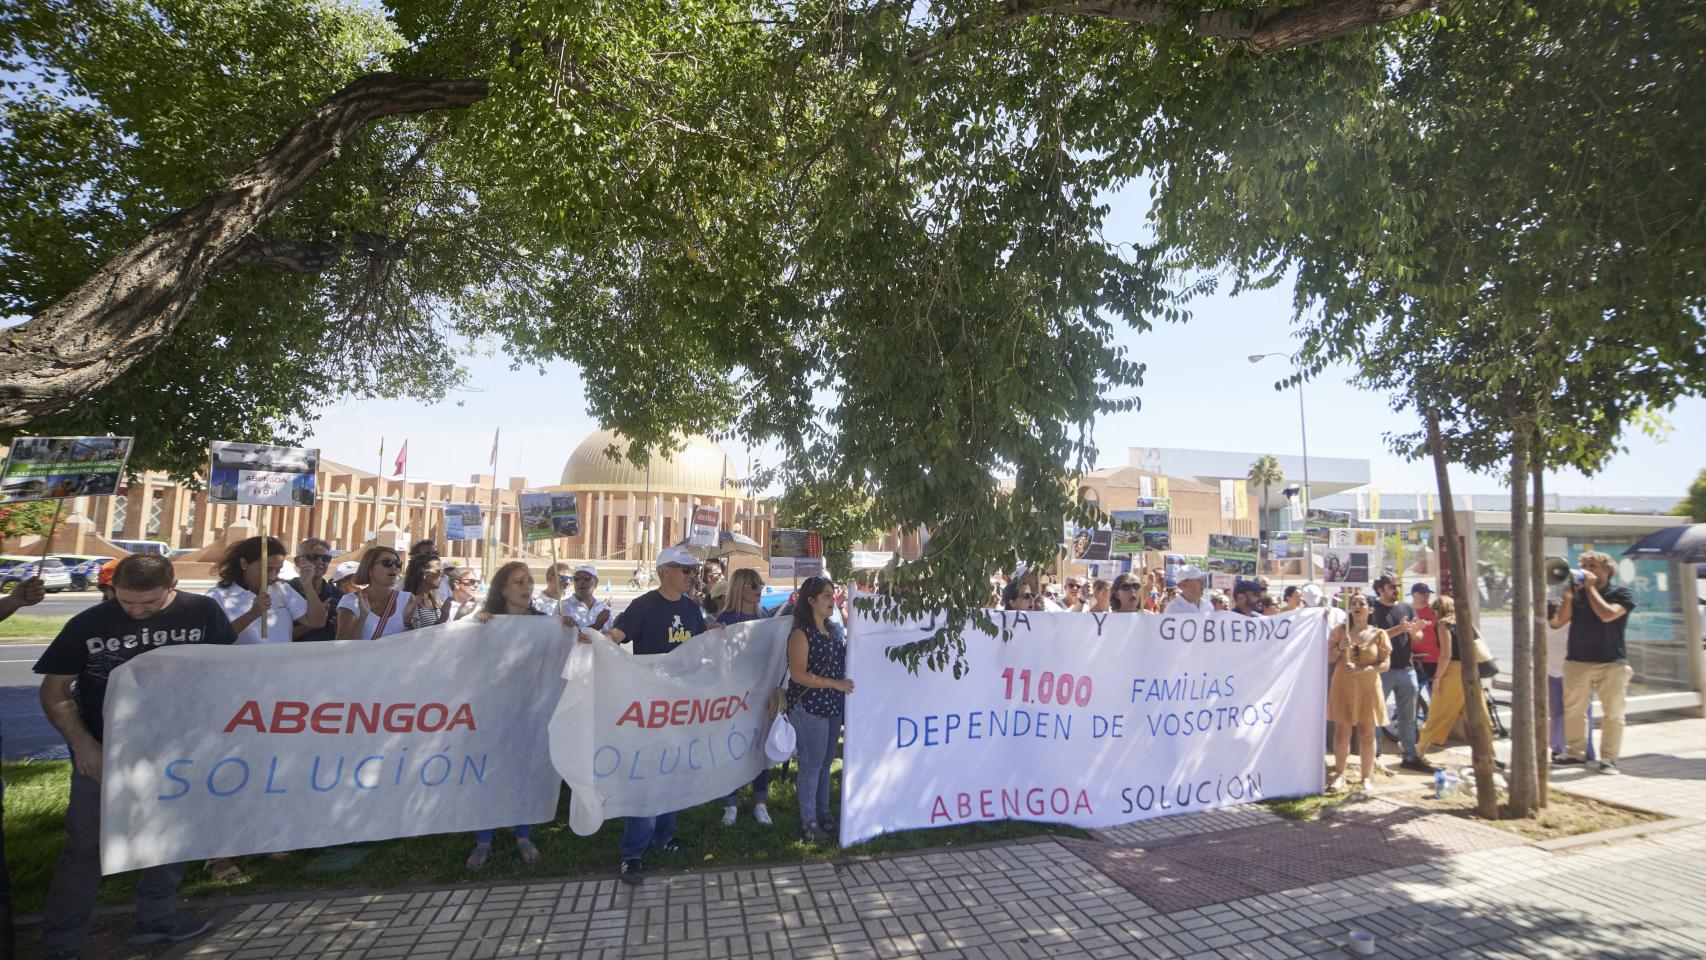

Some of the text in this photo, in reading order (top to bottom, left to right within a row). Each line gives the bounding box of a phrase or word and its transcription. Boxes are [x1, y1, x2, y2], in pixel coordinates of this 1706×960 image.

[1159, 617, 1292, 643] GOBIERNO
[1002, 667, 1093, 708] 11.000
[222, 700, 477, 734] ABENGOA
[897, 702, 1274, 749] DEPENDEN DE VOSOTROS
[930, 787, 1093, 824] ABENGOA
